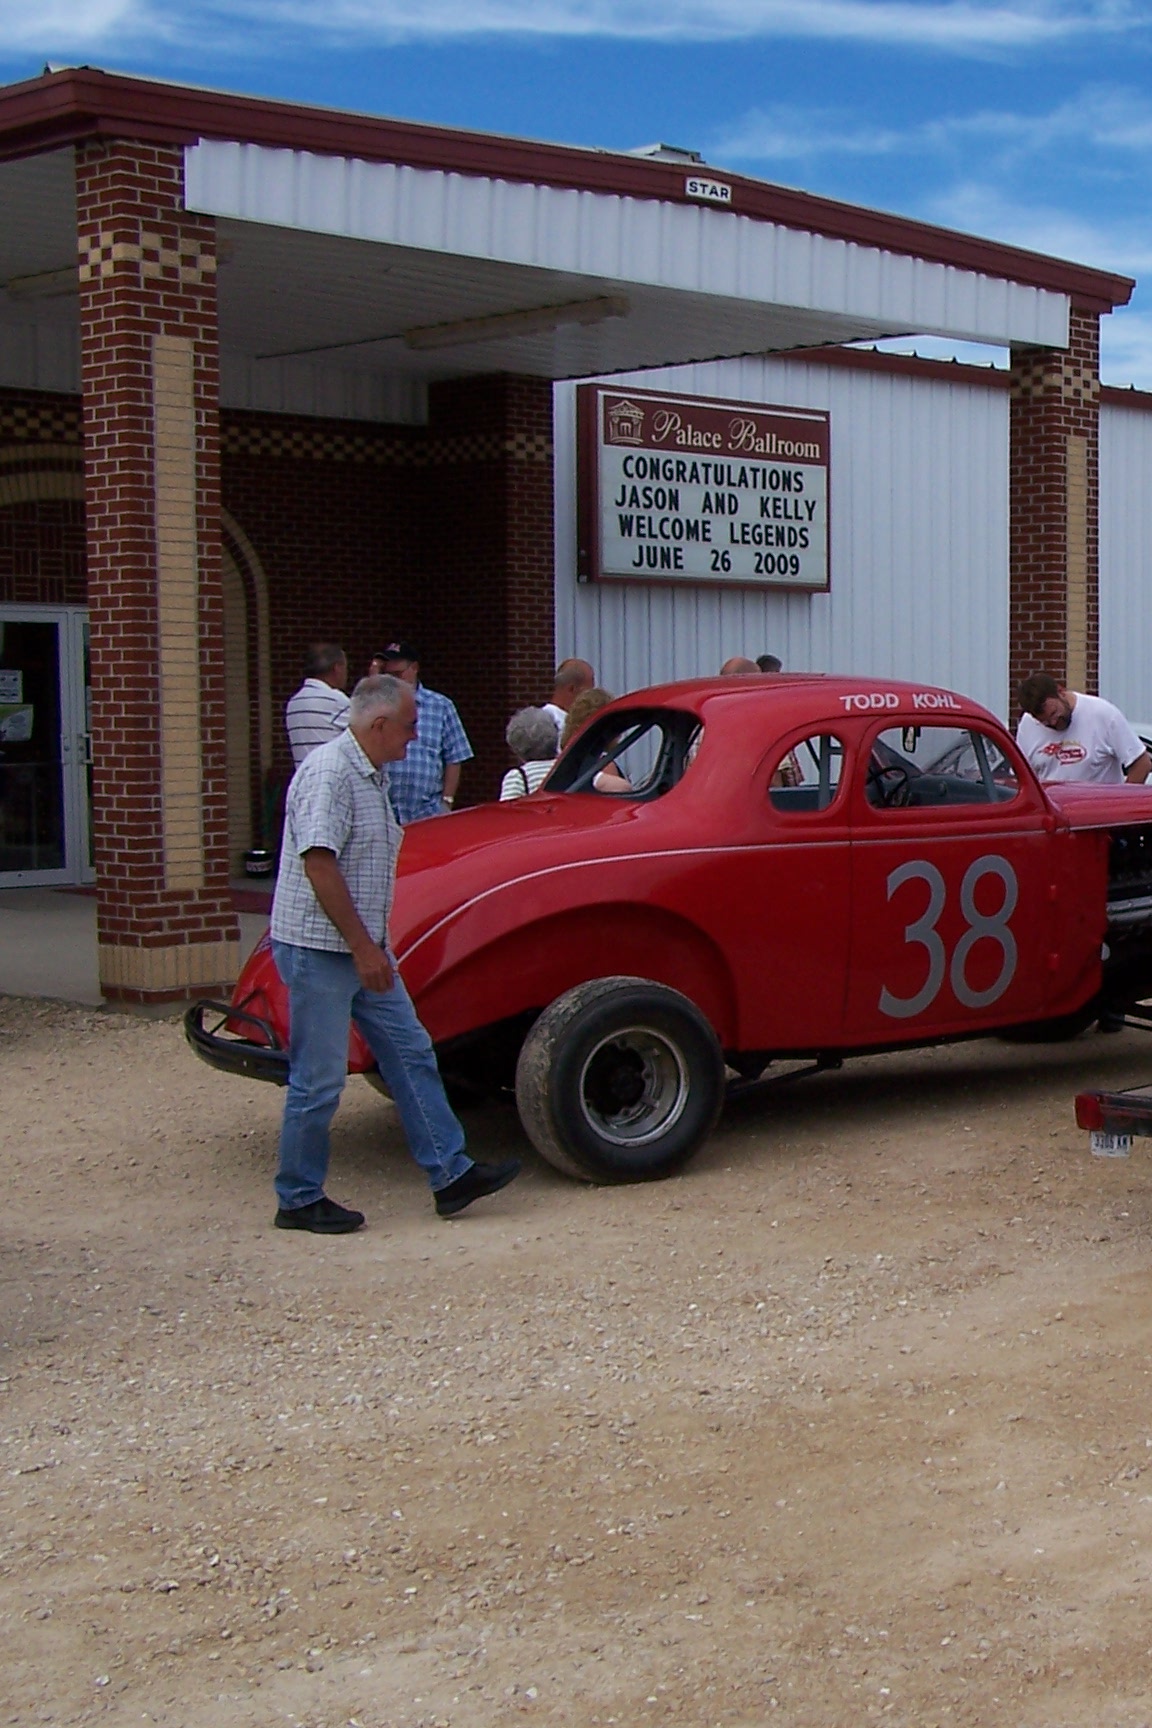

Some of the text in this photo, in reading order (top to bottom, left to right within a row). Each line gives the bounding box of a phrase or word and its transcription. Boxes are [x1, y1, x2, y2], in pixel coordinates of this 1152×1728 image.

[689, 181, 729, 199] STAR
[651, 410, 821, 459] Palace Ballroom
[622, 454, 804, 493] CONGRATULATIONS
[615, 484, 816, 522] JASON AND KELLY
[618, 514, 810, 549] WELCOME LEGENDS
[632, 545, 800, 576] JUNE 26 2009
[839, 693, 962, 711] TODD KOHL
[878, 854, 1019, 1018] 38
